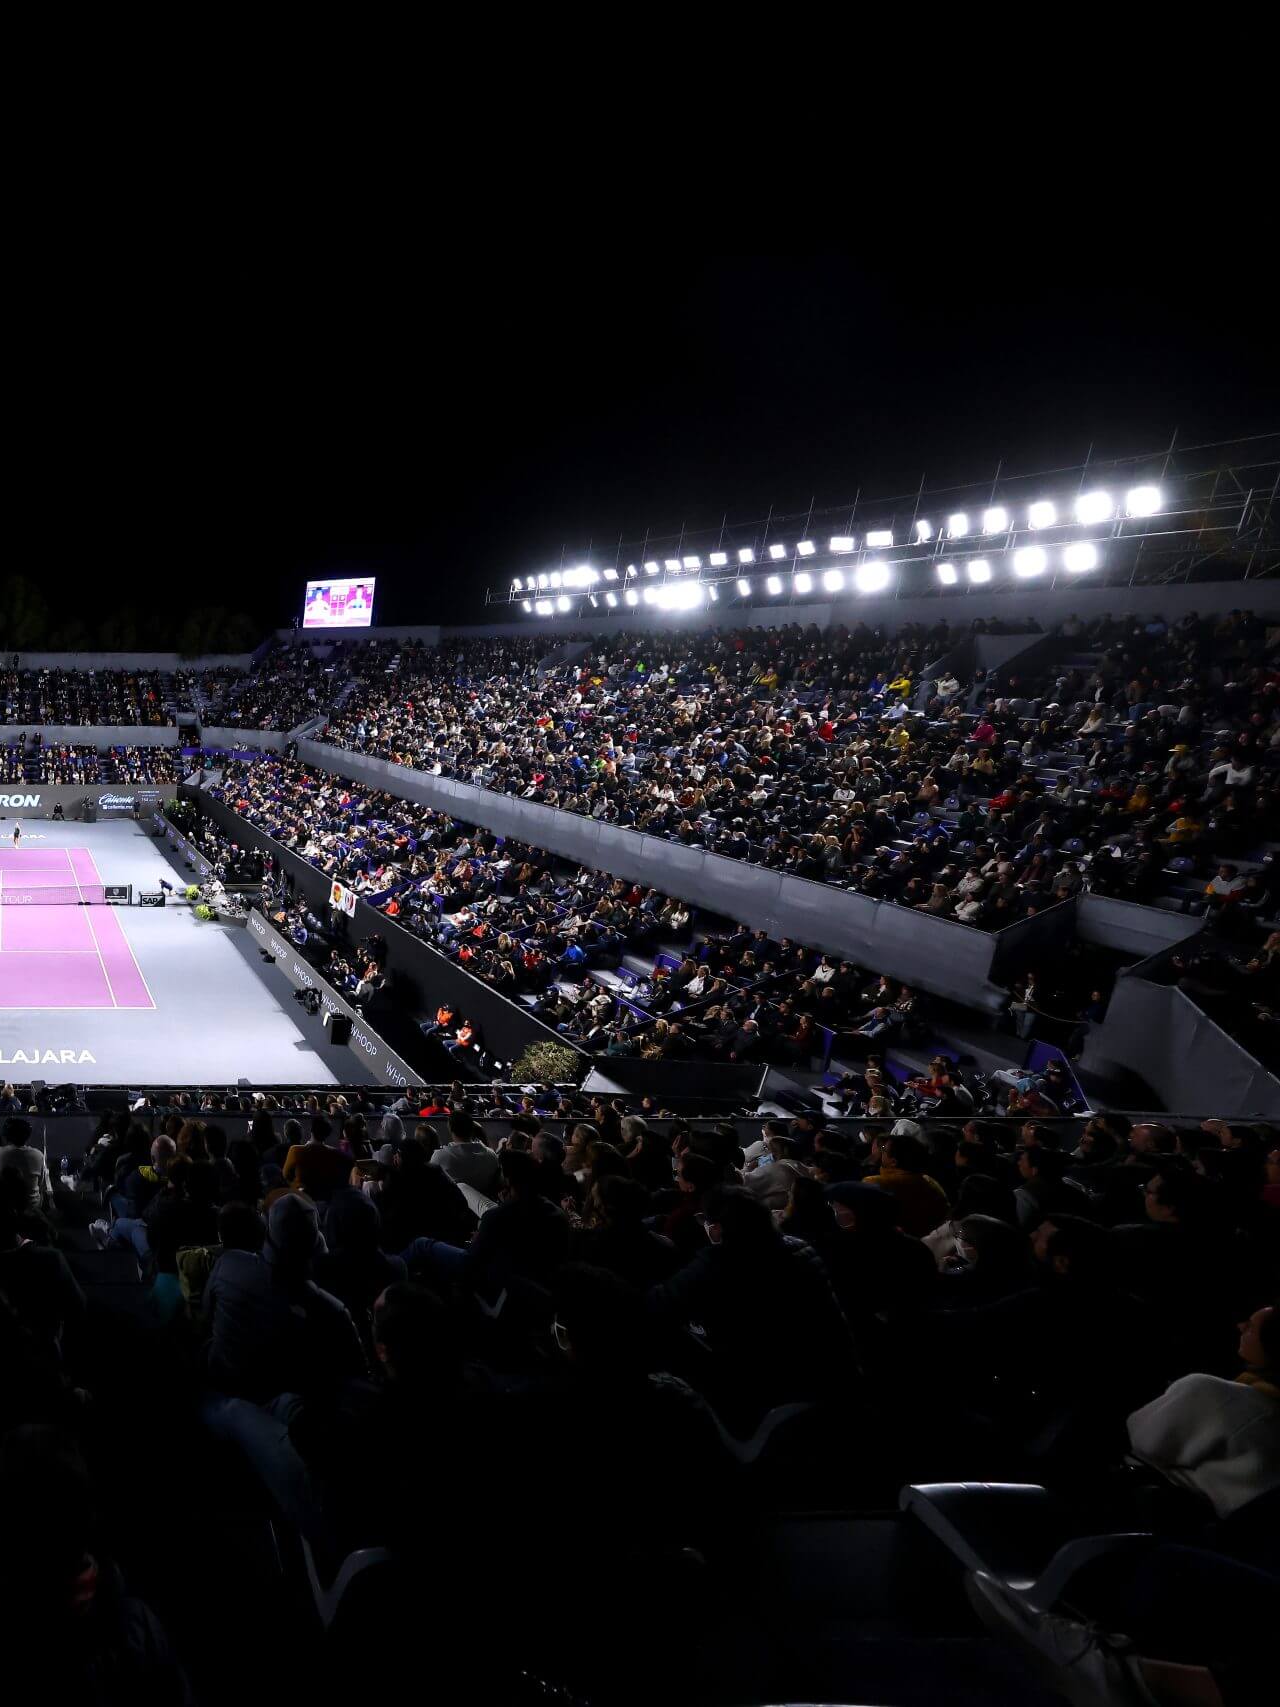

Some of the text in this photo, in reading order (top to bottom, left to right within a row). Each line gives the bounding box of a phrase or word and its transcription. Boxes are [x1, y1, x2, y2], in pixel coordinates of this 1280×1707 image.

[3, 895, 33, 904] TOUR
[270, 938, 287, 959] WHOOP
[293, 962, 313, 986] WHOOP
[321, 992, 344, 1015] WHOO
[350, 1023, 378, 1056] WHOOP
